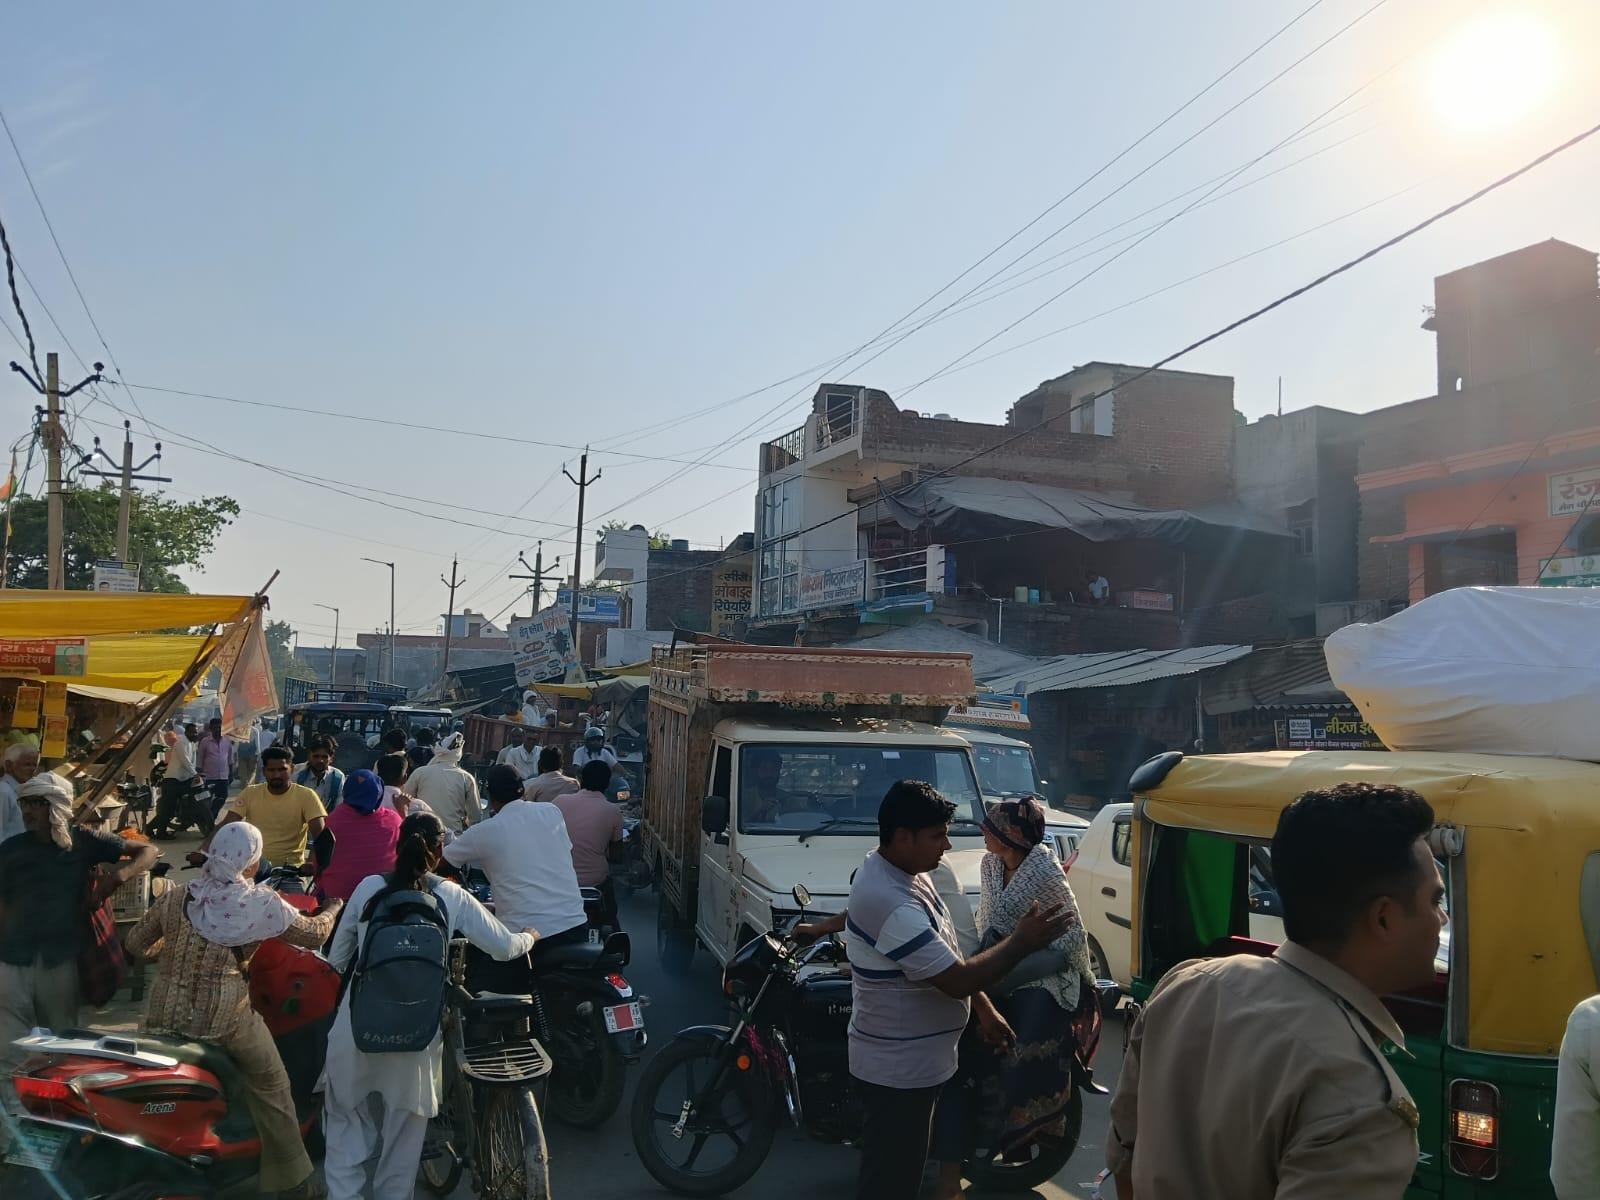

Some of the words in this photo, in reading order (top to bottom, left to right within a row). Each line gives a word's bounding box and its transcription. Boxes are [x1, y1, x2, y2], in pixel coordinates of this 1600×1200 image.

[1325, 716, 1357, 734] नीरज
[839, 1005, 852, 1014] He
[143, 1102, 177, 1114] Arena
